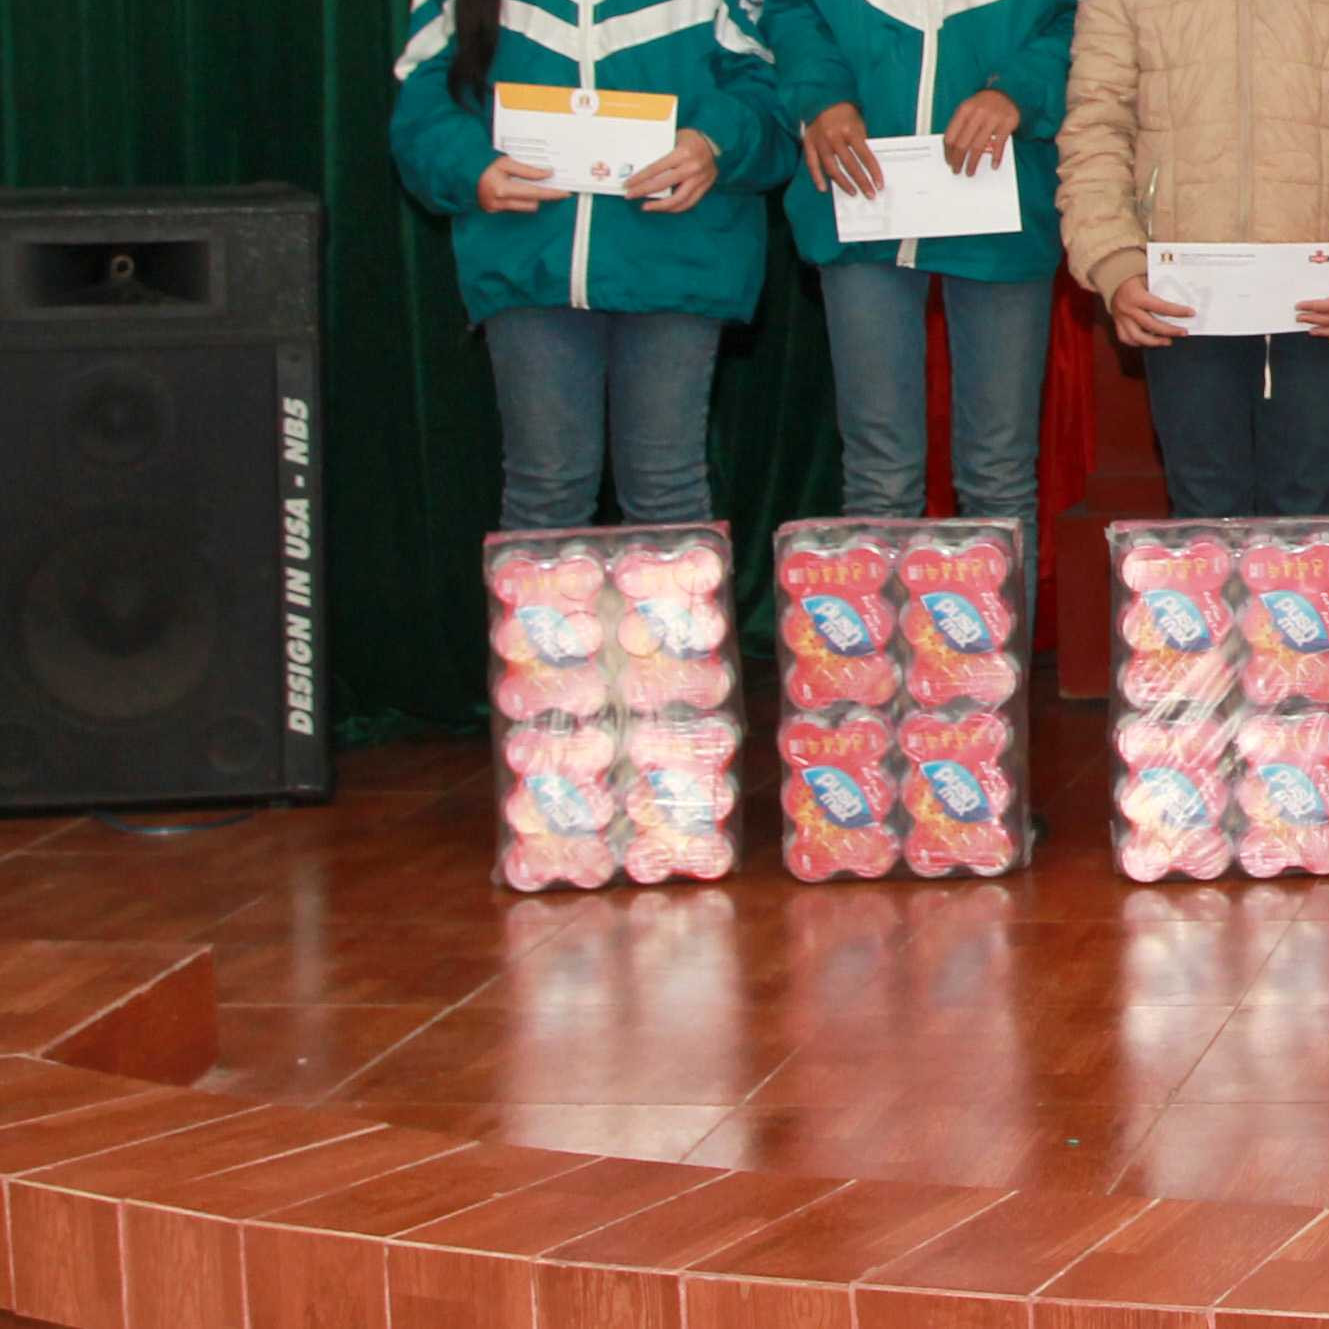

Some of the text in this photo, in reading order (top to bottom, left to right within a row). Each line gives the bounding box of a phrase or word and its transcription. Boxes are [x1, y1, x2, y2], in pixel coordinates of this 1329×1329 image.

[284, 498, 311, 560] USA
[285, 567, 312, 607] IN
[287, 613, 313, 735] DESIGN
